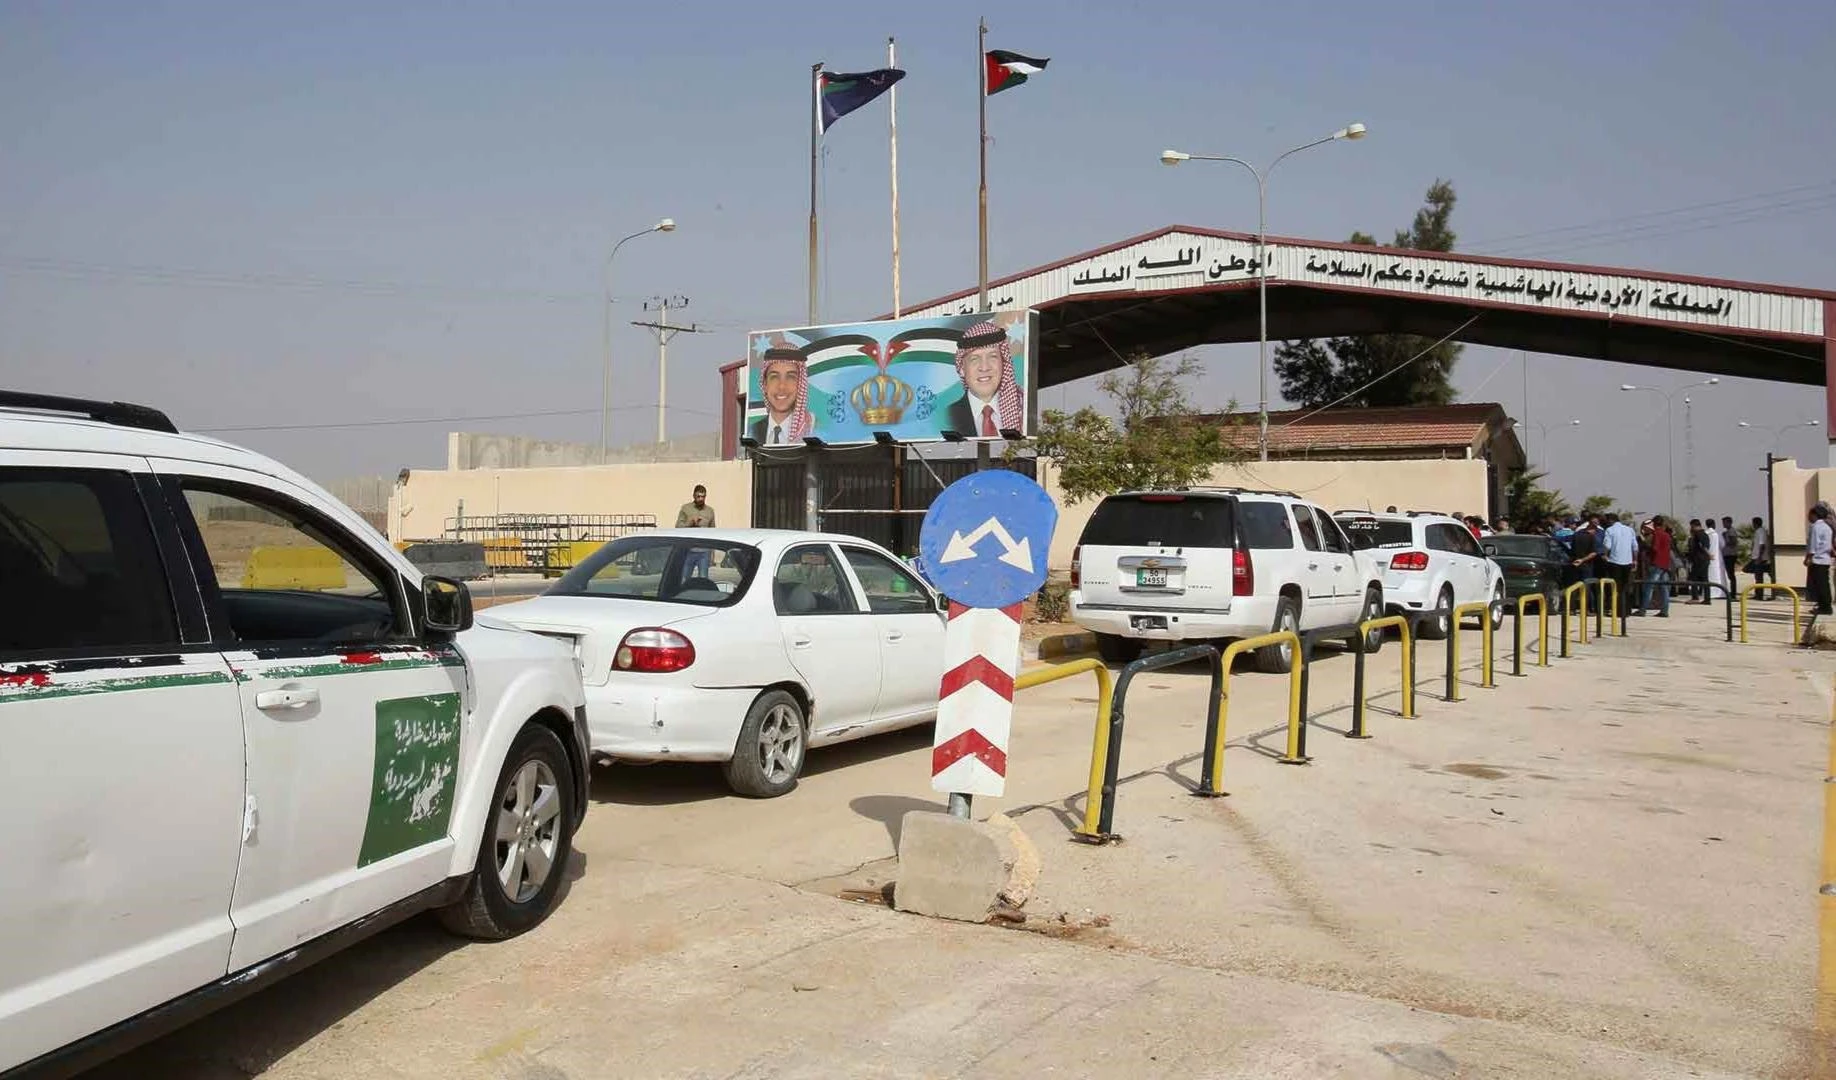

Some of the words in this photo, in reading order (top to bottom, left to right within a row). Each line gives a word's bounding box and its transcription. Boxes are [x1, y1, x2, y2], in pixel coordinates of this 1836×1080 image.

[1138, 245, 1201, 269] الله
[1306, 255, 1372, 282] السلامة
[1073, 264, 1131, 286] الملك
[1373, 262, 1469, 290] تستودعكم
[1475, 272, 1563, 302] الهاشمية
[1649, 288, 1733, 318] المملكة
